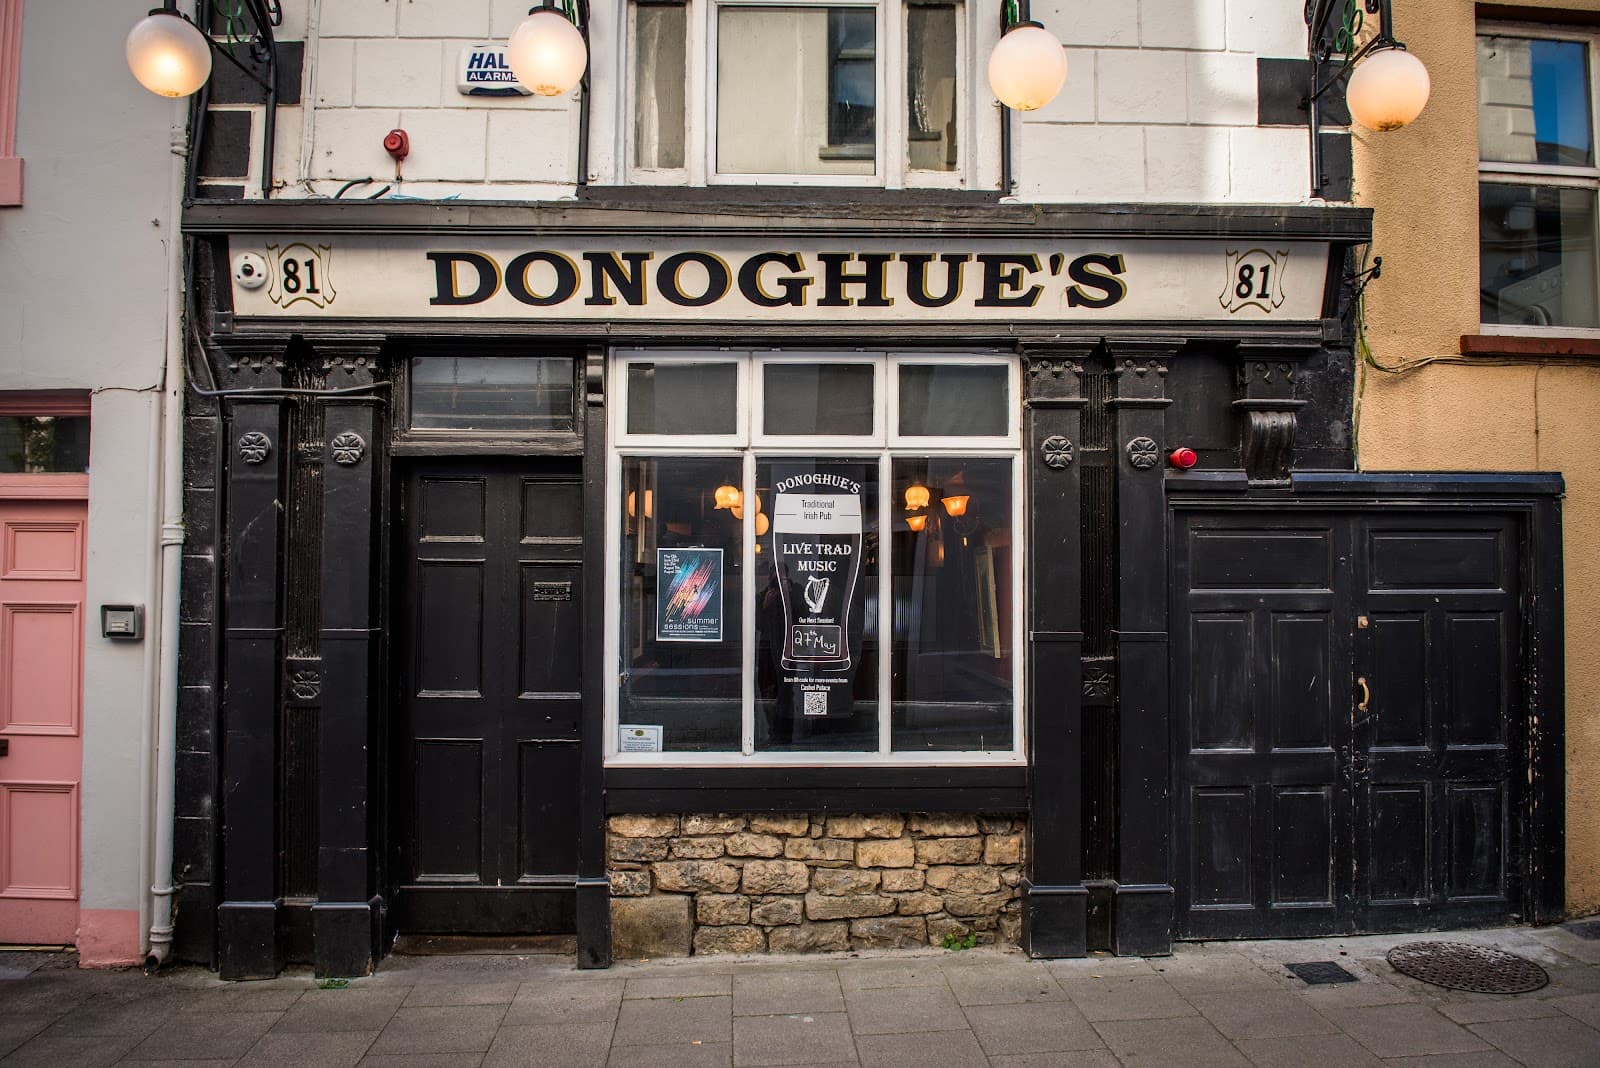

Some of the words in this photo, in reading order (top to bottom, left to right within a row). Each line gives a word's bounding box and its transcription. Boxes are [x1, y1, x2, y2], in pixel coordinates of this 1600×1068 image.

[283, 258, 320, 293] 81
[426, 250, 1127, 308] DONOGHUE'S
[1236, 264, 1270, 298] 81
[776, 474, 861, 494] DONOGHUE'S
[801, 500, 835, 508] Traditional
[803, 512, 818, 520] Irish
[819, 512, 832, 520] Pub
[783, 542, 813, 555] LIVE
[816, 543, 852, 555] TRAD
[797, 560, 837, 572] MUSIC
[664, 622, 699, 630] sessions
[794, 629, 817, 647] 27th
[814, 635, 836, 654] May
